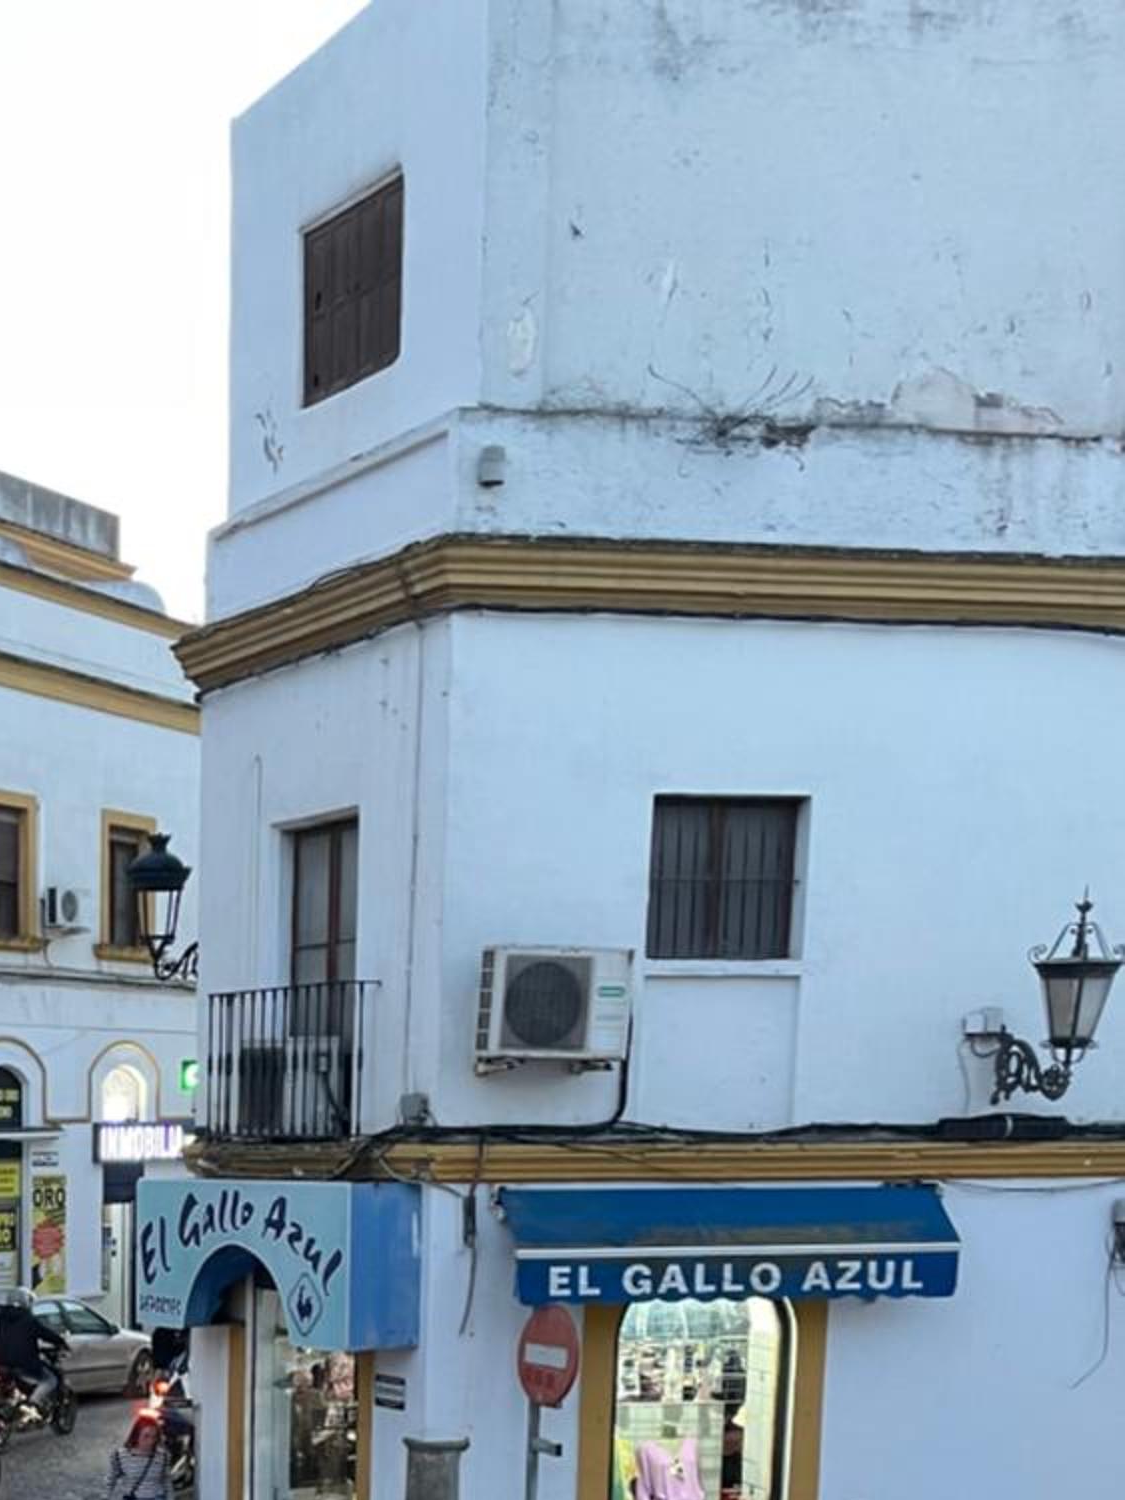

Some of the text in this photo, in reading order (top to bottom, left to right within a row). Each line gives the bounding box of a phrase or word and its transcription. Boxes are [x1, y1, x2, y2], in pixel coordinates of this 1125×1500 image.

[33, 1188, 66, 1208] ORO
[140, 1215, 172, 1286] El
[178, 1189, 255, 1249] Gallo
[261, 1196, 343, 1297] Azul
[548, 1258, 924, 1298] EL GALLO AZUL
